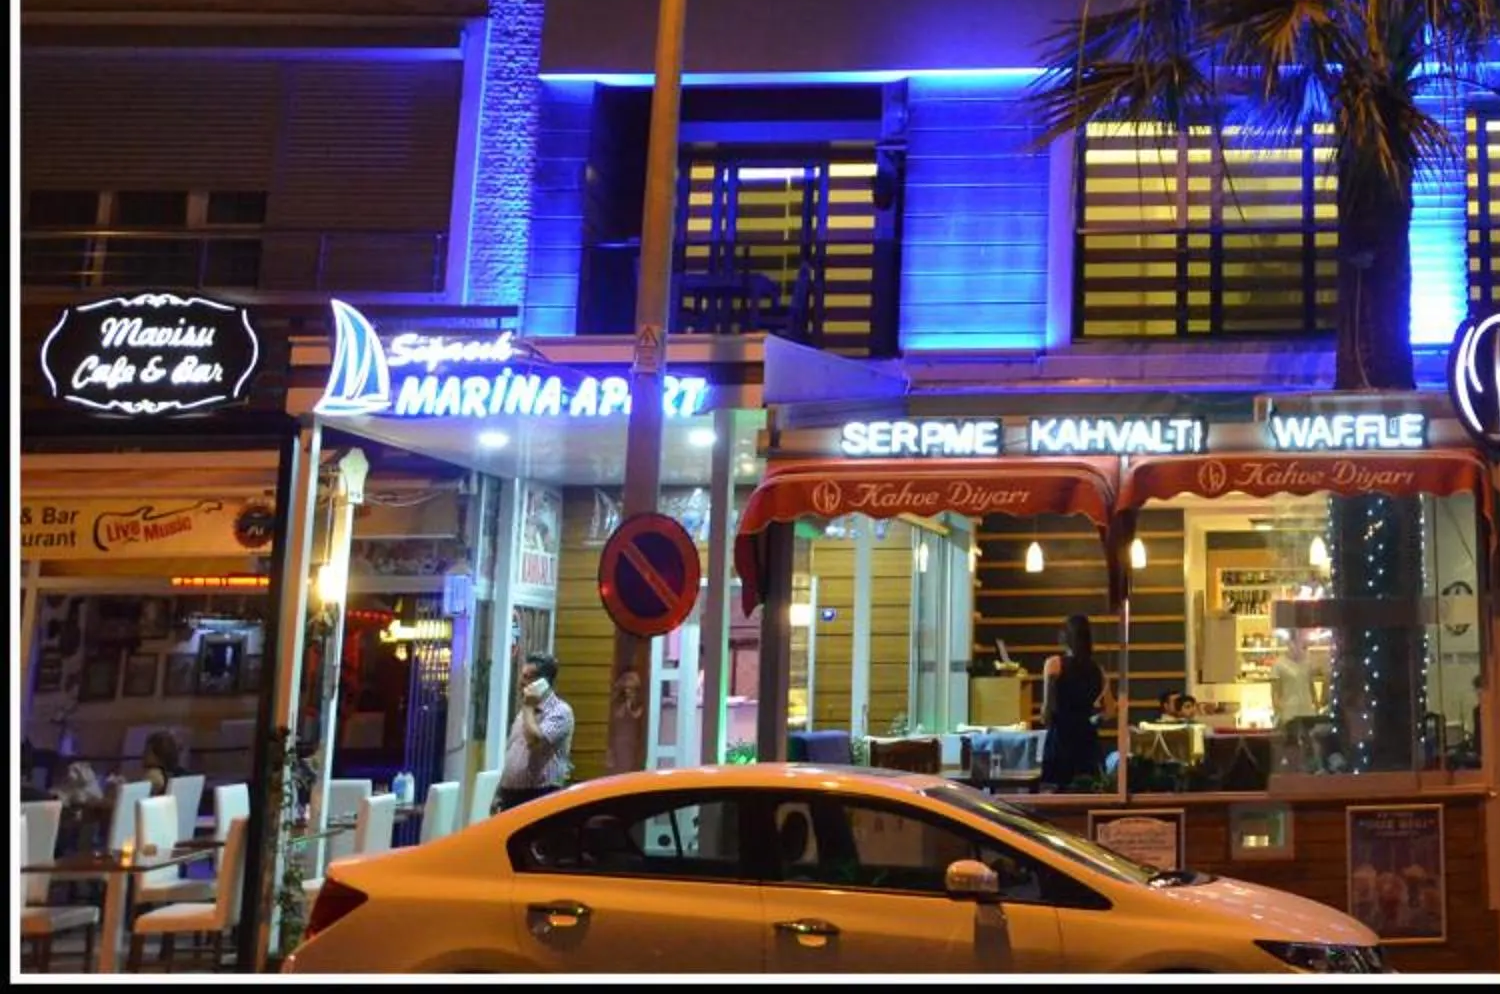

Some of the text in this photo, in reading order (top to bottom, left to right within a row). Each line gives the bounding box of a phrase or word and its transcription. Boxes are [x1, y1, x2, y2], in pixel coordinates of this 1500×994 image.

[101, 317, 216, 348] Mavisu
[71, 355, 223, 389] Cafe & Bar
[395, 367, 707, 418] MARİNA APRT
[840, 418, 1202, 455] SERPME KAHVALTI
[1273, 413, 1425, 448] WAFFLE
[1234, 461, 1325, 487] Kahve
[850, 481, 939, 507] Kahve
[42, 506, 80, 525] Bar
[106, 520, 141, 543] Live
